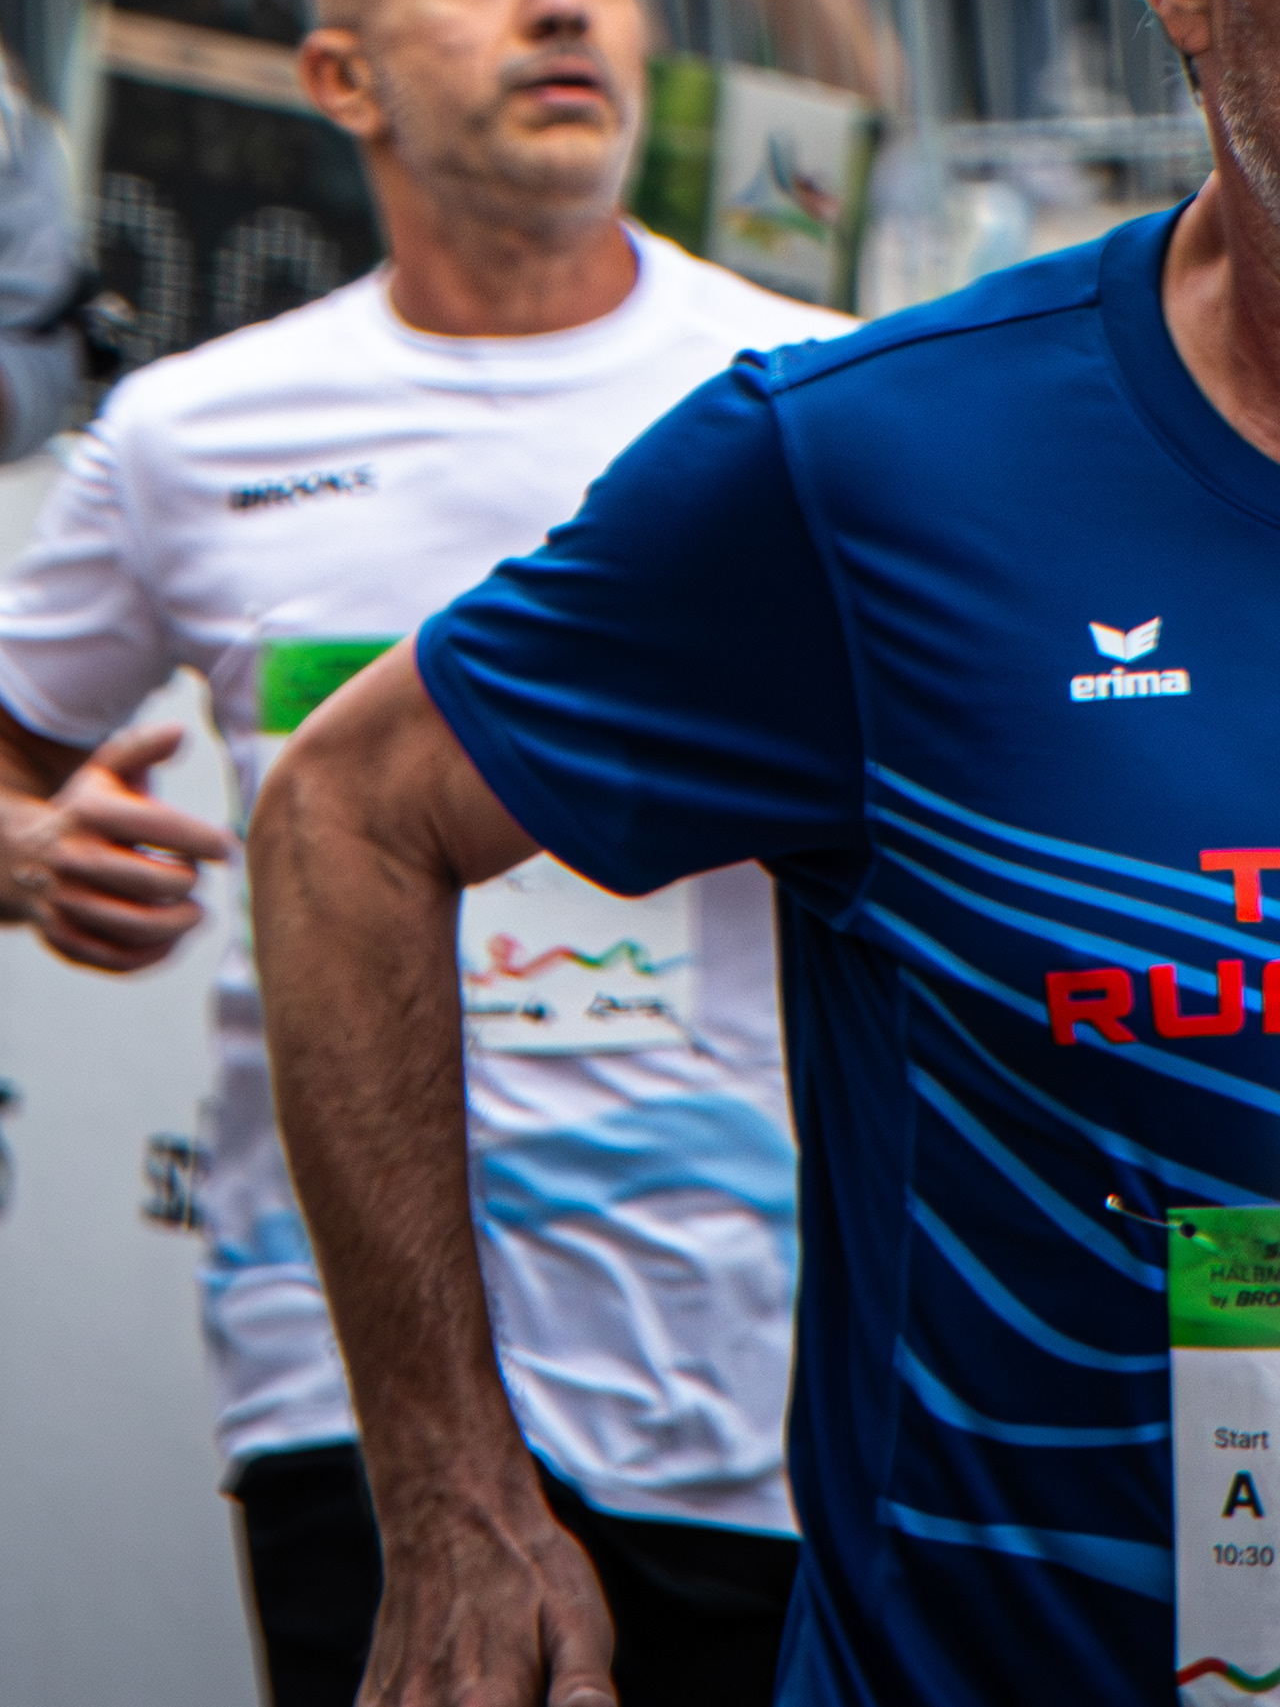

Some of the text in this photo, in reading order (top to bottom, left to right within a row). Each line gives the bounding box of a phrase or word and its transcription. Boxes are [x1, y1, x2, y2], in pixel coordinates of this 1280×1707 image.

[1070, 666, 1190, 702] erima
[1214, 1427, 1269, 1449] Start
[1222, 1470, 1264, 1518] A
[1213, 1544, 1275, 1567] 10:30
